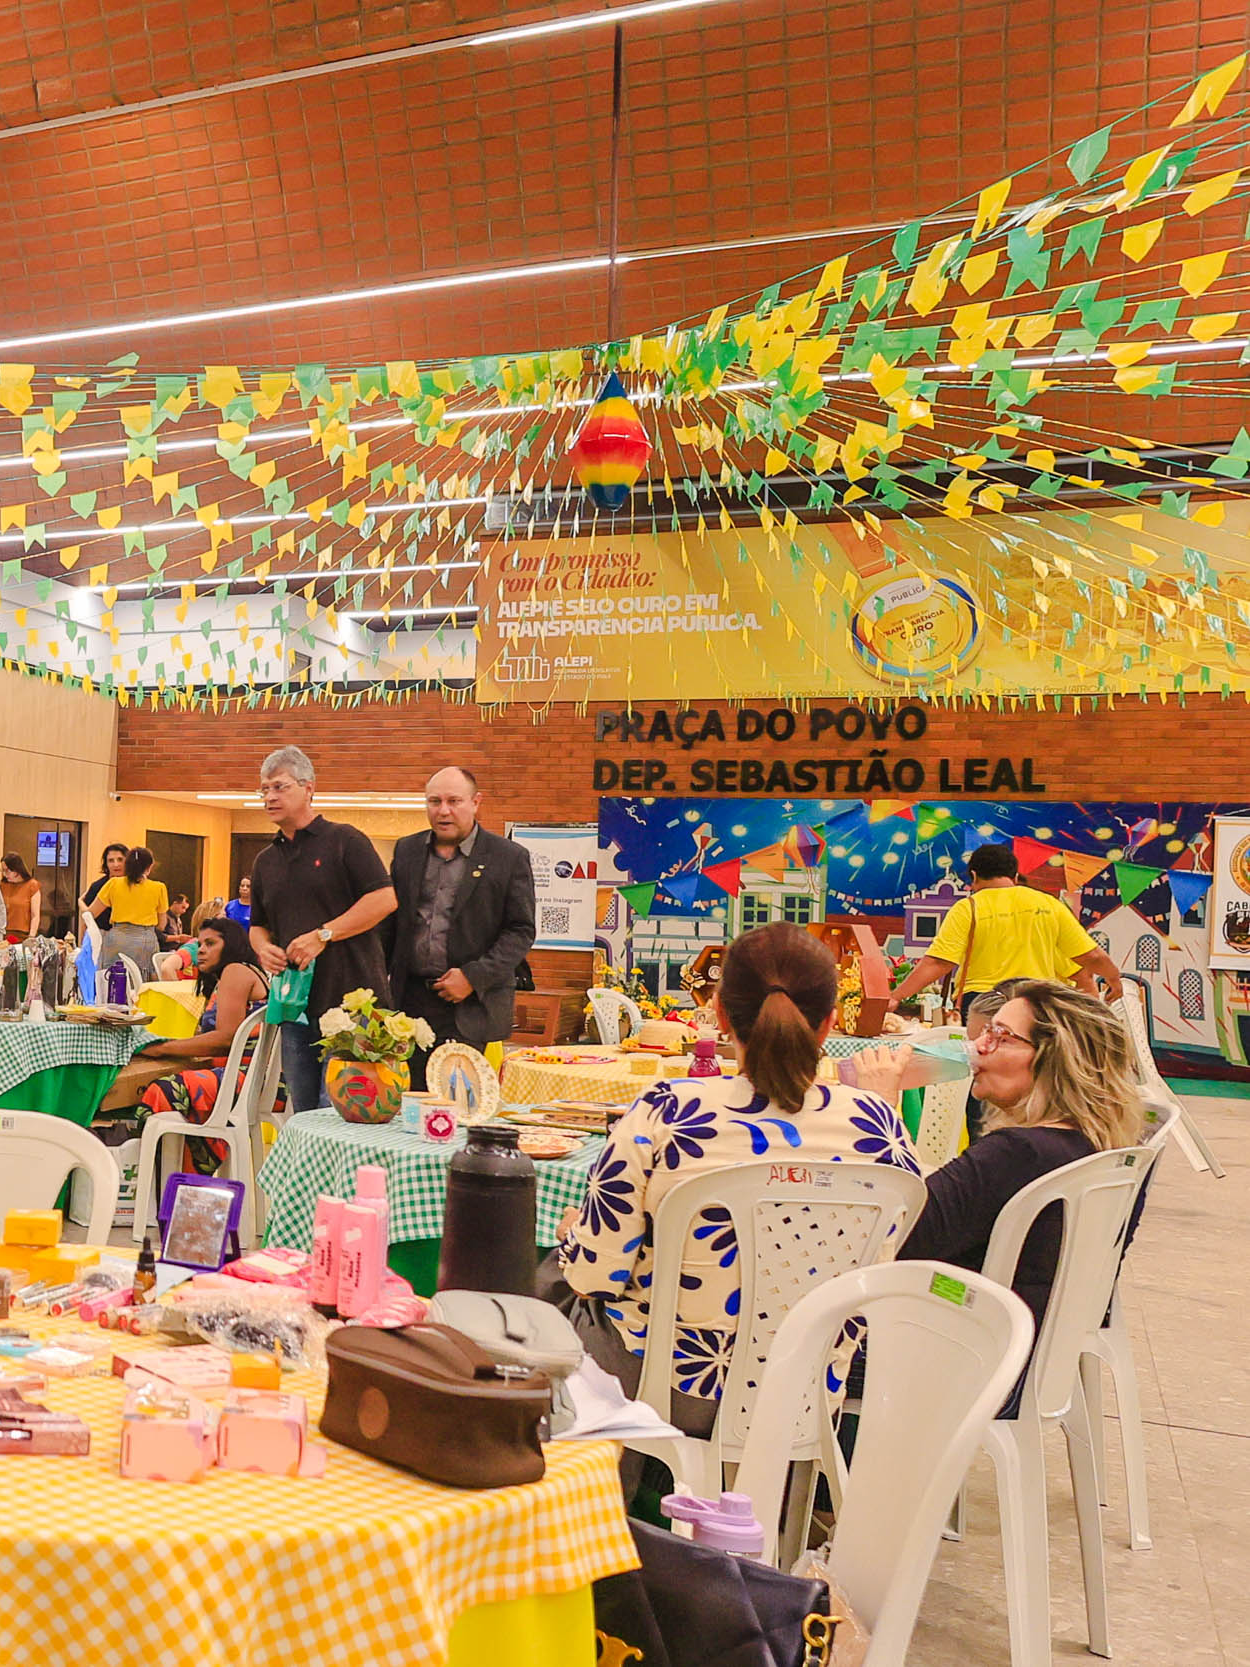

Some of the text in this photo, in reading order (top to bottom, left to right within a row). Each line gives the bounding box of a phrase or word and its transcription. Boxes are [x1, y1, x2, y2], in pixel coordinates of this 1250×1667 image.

[544, 576, 557, 591] o
[497, 601, 548, 618] ALEPI
[565, 598, 615, 616] SELO
[617, 595, 682, 614] OURO
[685, 593, 719, 611] EM
[497, 615, 665, 639] TRANSPARÊNCIA
[554, 656, 593, 667] ALEPI
[594, 706, 926, 749] PRAÇA DO POVO
[593, 749, 1046, 792] DEP. SEBASTIÃO LEAL
